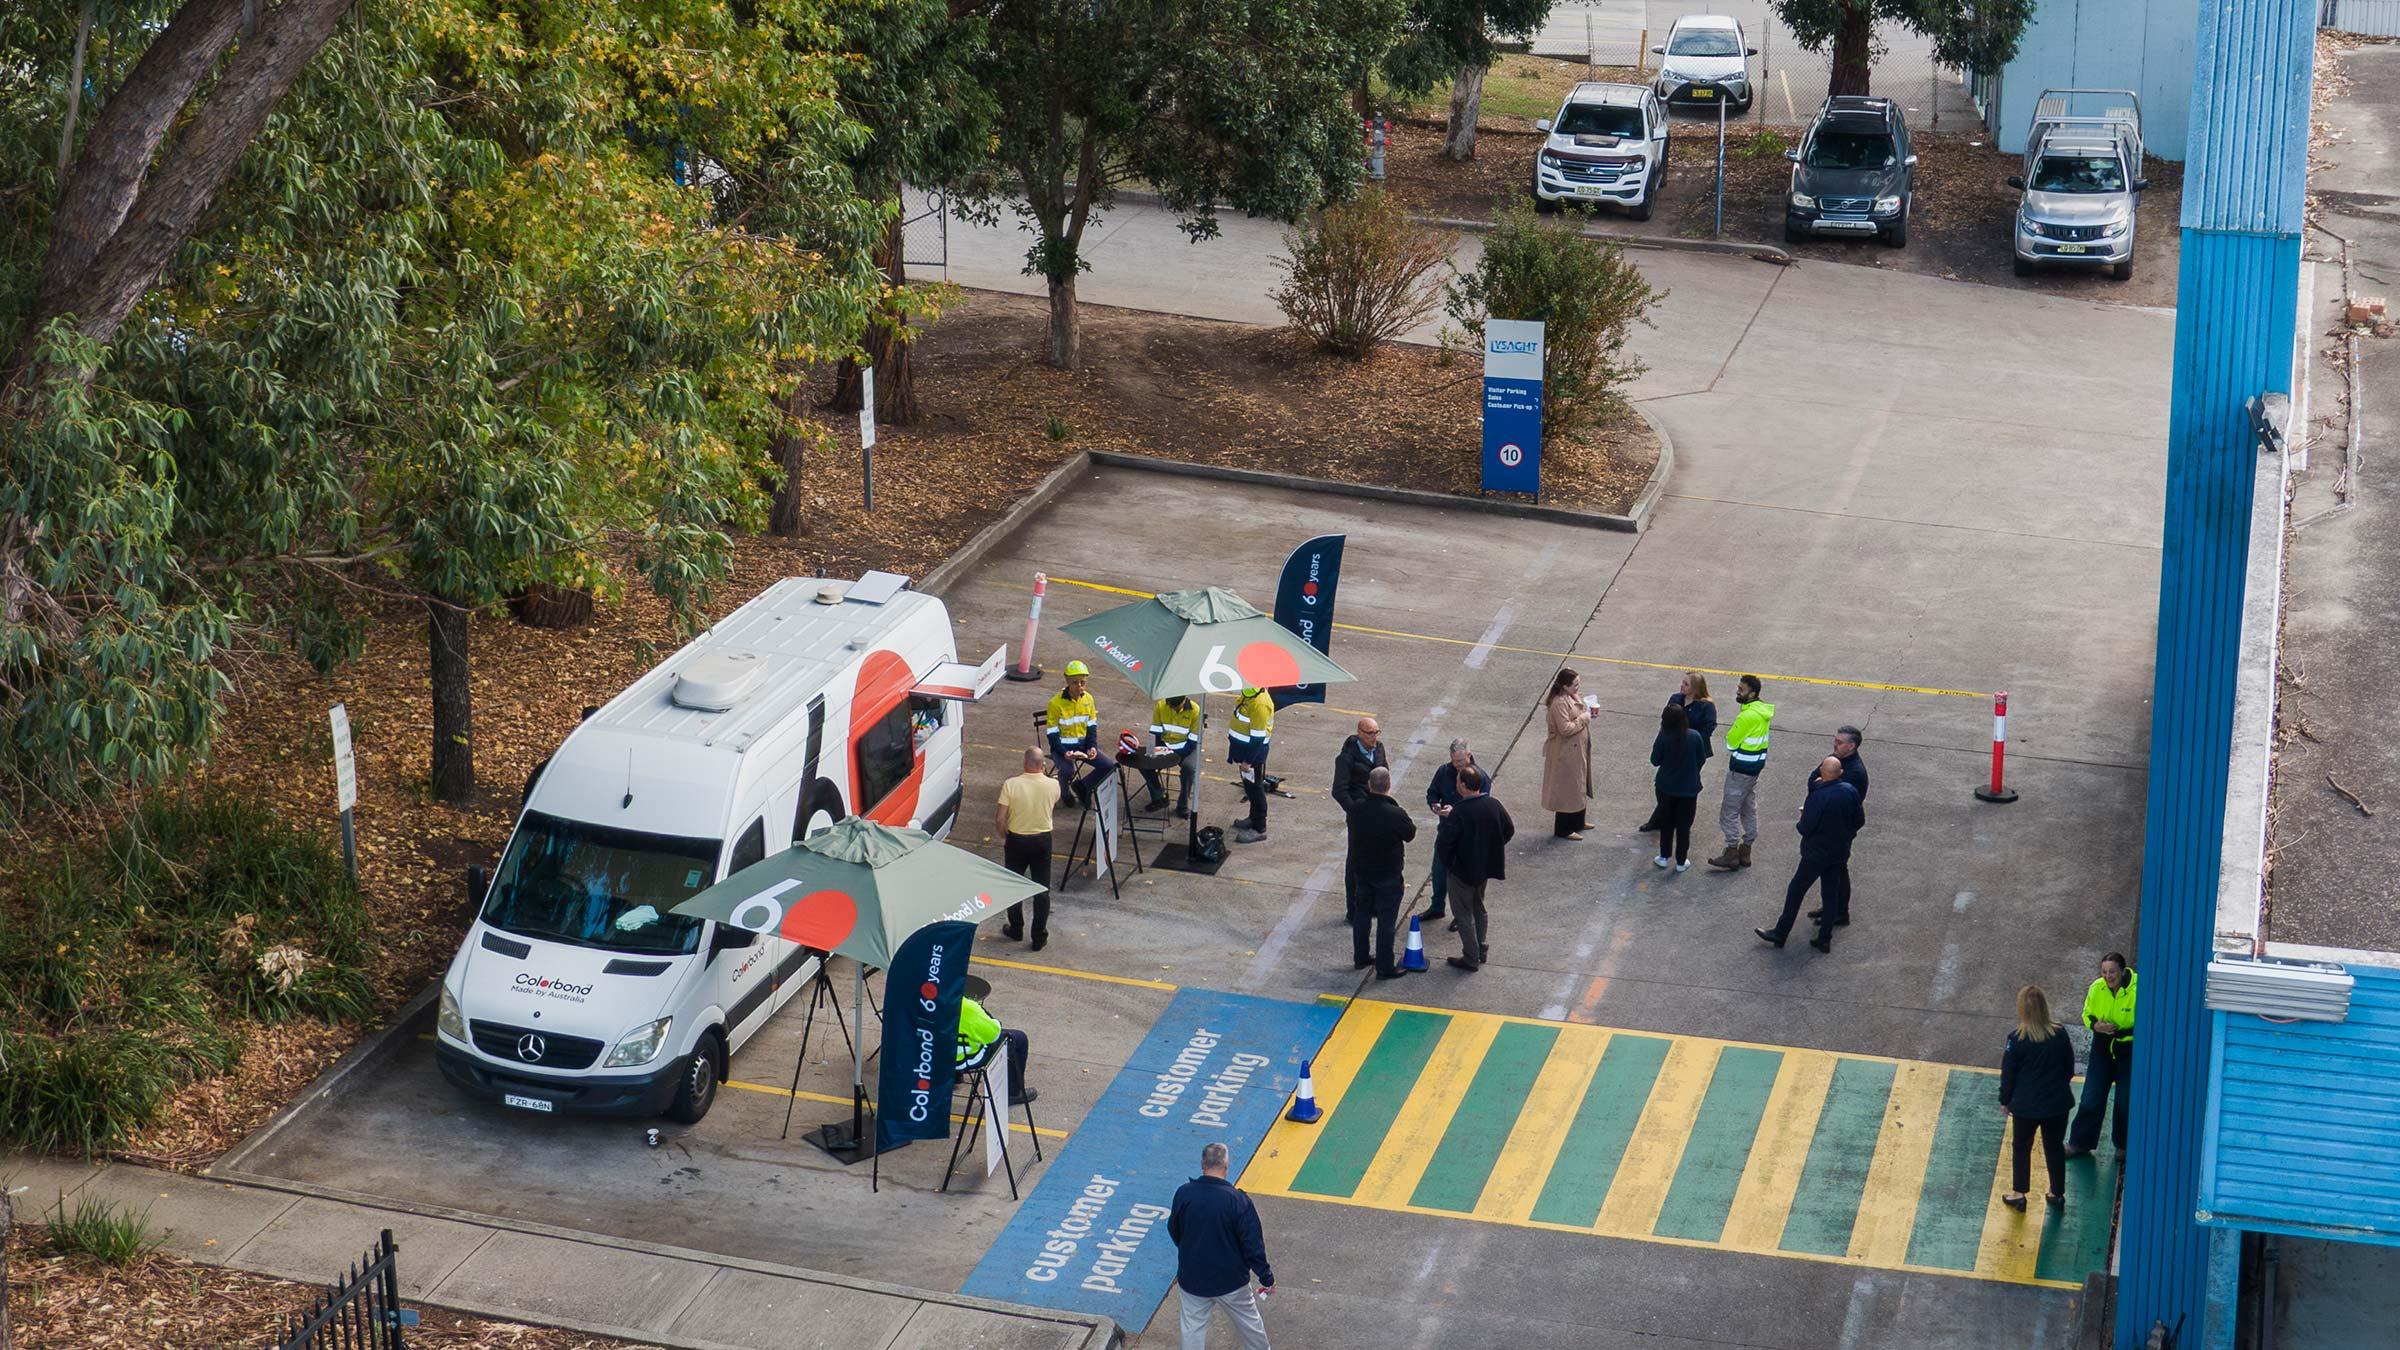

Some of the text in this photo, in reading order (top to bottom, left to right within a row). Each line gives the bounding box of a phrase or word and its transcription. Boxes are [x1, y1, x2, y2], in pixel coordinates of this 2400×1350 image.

[1491, 340, 1538, 355] LYSAGHT
[1503, 449, 1518, 462] 10
[511, 985, 585, 1003] Made by Australia
[1139, 1028, 1222, 1118] customer
[1188, 1052, 1270, 1128] parking
[1026, 1174, 1120, 1282] customer
[1080, 1203, 1172, 1294] parking
